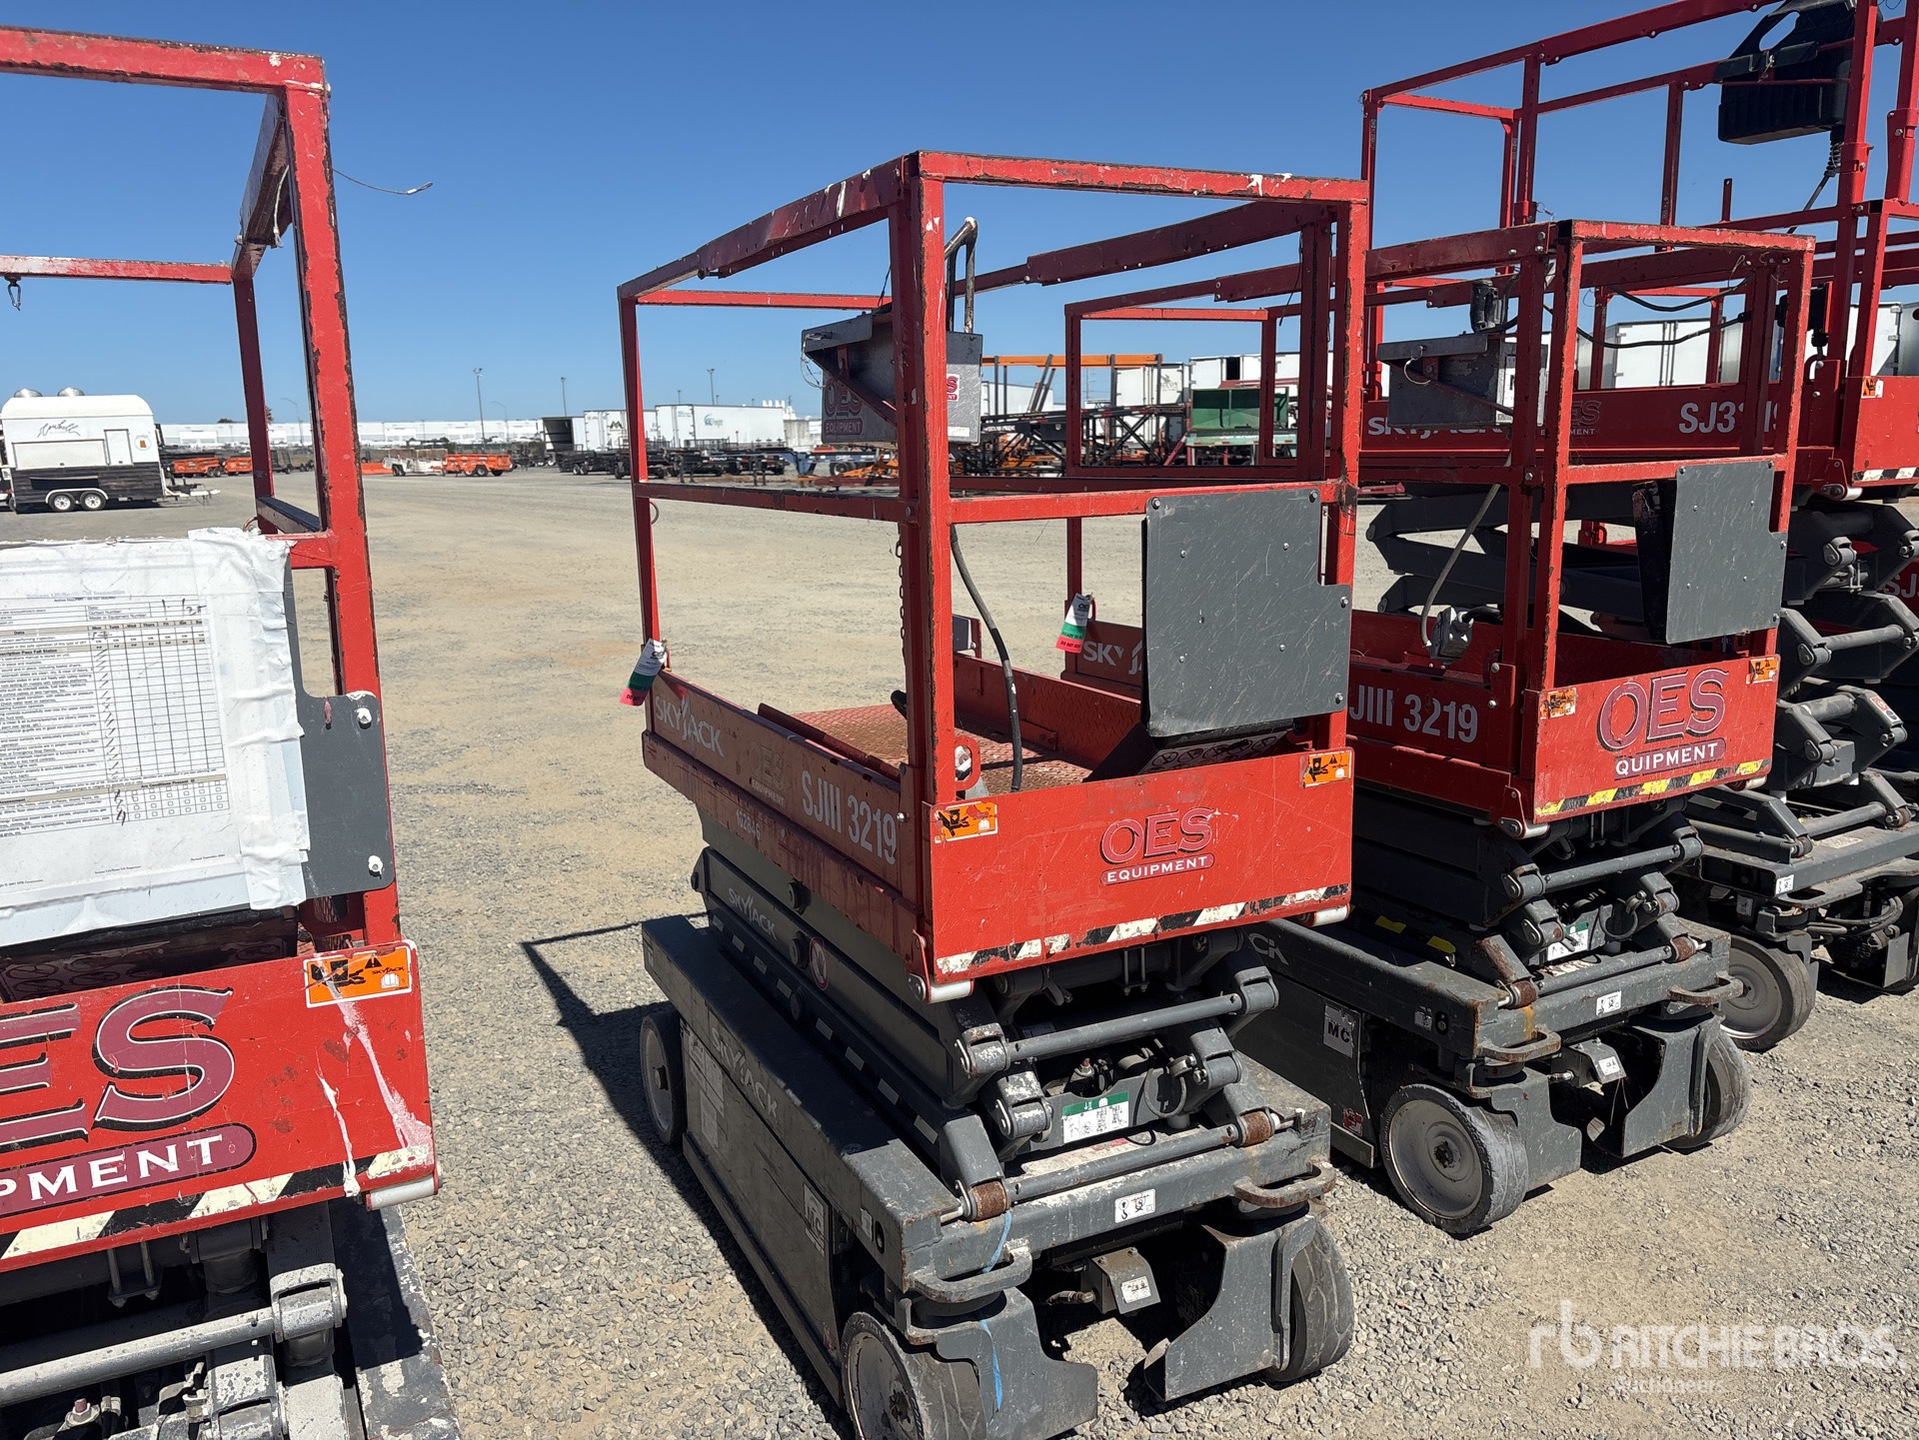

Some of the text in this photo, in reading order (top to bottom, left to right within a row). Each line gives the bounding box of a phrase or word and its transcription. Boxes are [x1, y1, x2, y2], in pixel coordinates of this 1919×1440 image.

[655, 696, 724, 757] SKYJACK
[1350, 684, 1478, 743] JIII 3219
[1597, 668, 1729, 752] OES
[1615, 743, 1719, 776] QUIPMENT
[847, 794, 897, 866] 3219
[1100, 807, 1216, 865] OES
[1106, 857, 1208, 883] EQUIPMENT
[728, 887, 777, 941] SKYJACK
[1328, 1022, 1350, 1043] MC
[711, 1026, 777, 1119] SKYJACK
